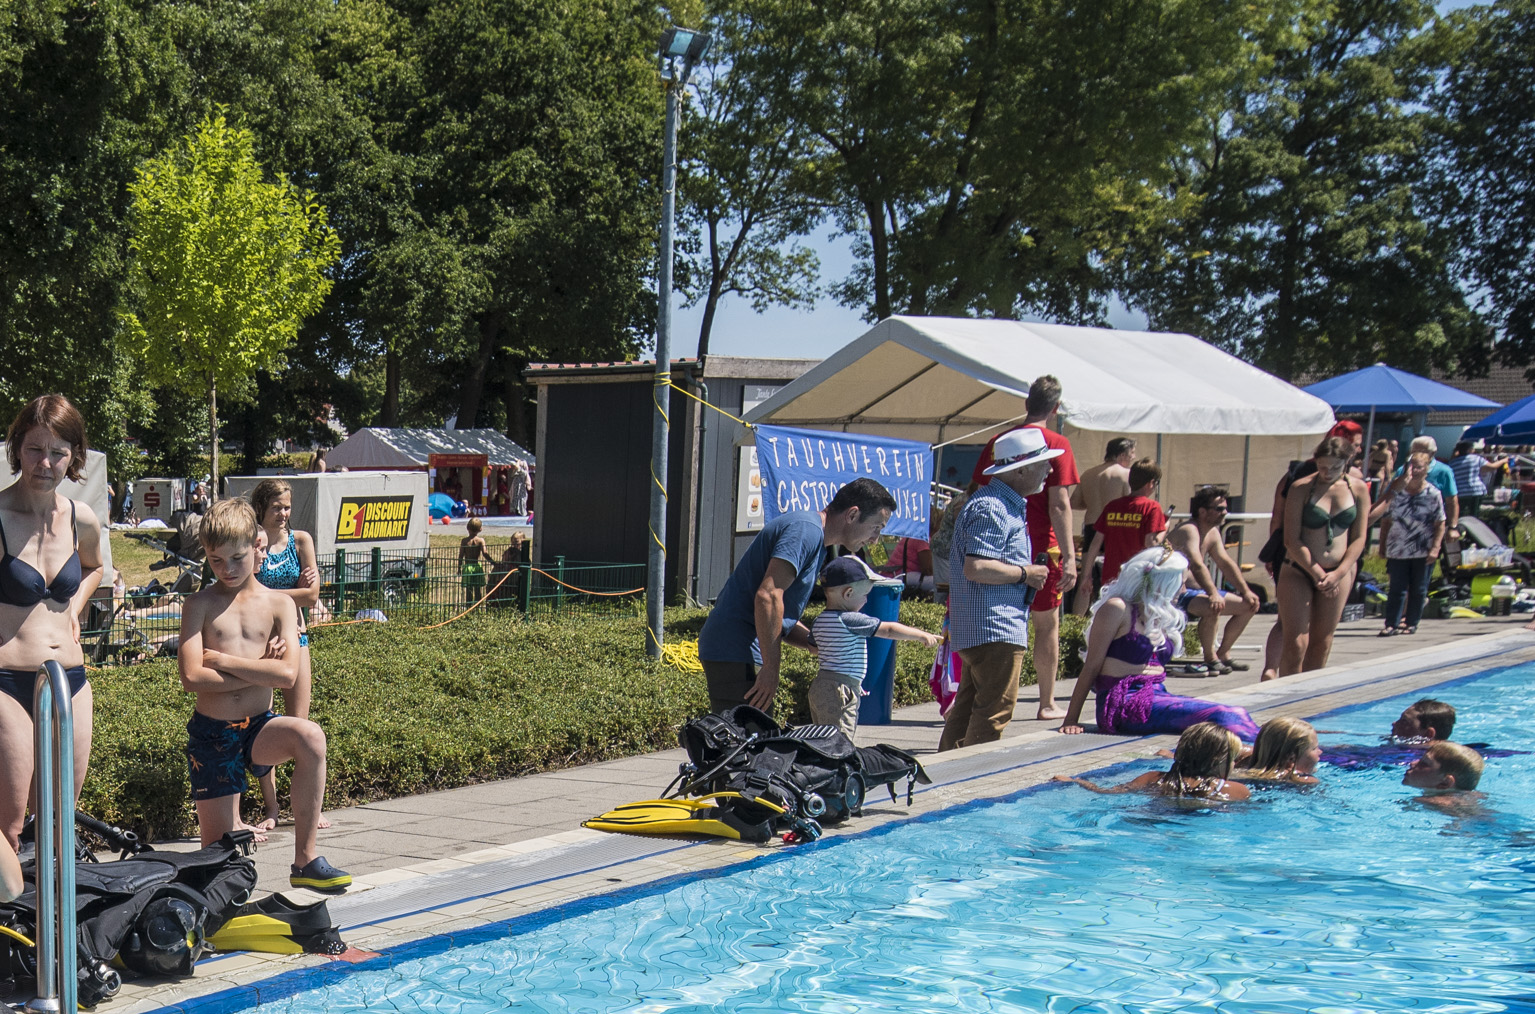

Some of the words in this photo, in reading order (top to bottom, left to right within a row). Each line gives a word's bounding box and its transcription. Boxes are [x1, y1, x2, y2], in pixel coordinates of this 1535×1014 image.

[769, 437, 924, 482] TAUCHVEREIN
[337, 502, 367, 538] B1
[365, 501, 411, 521] DISCOUNT
[362, 520, 408, 539] BAUMARKT
[1107, 512, 1142, 522] DLRG
